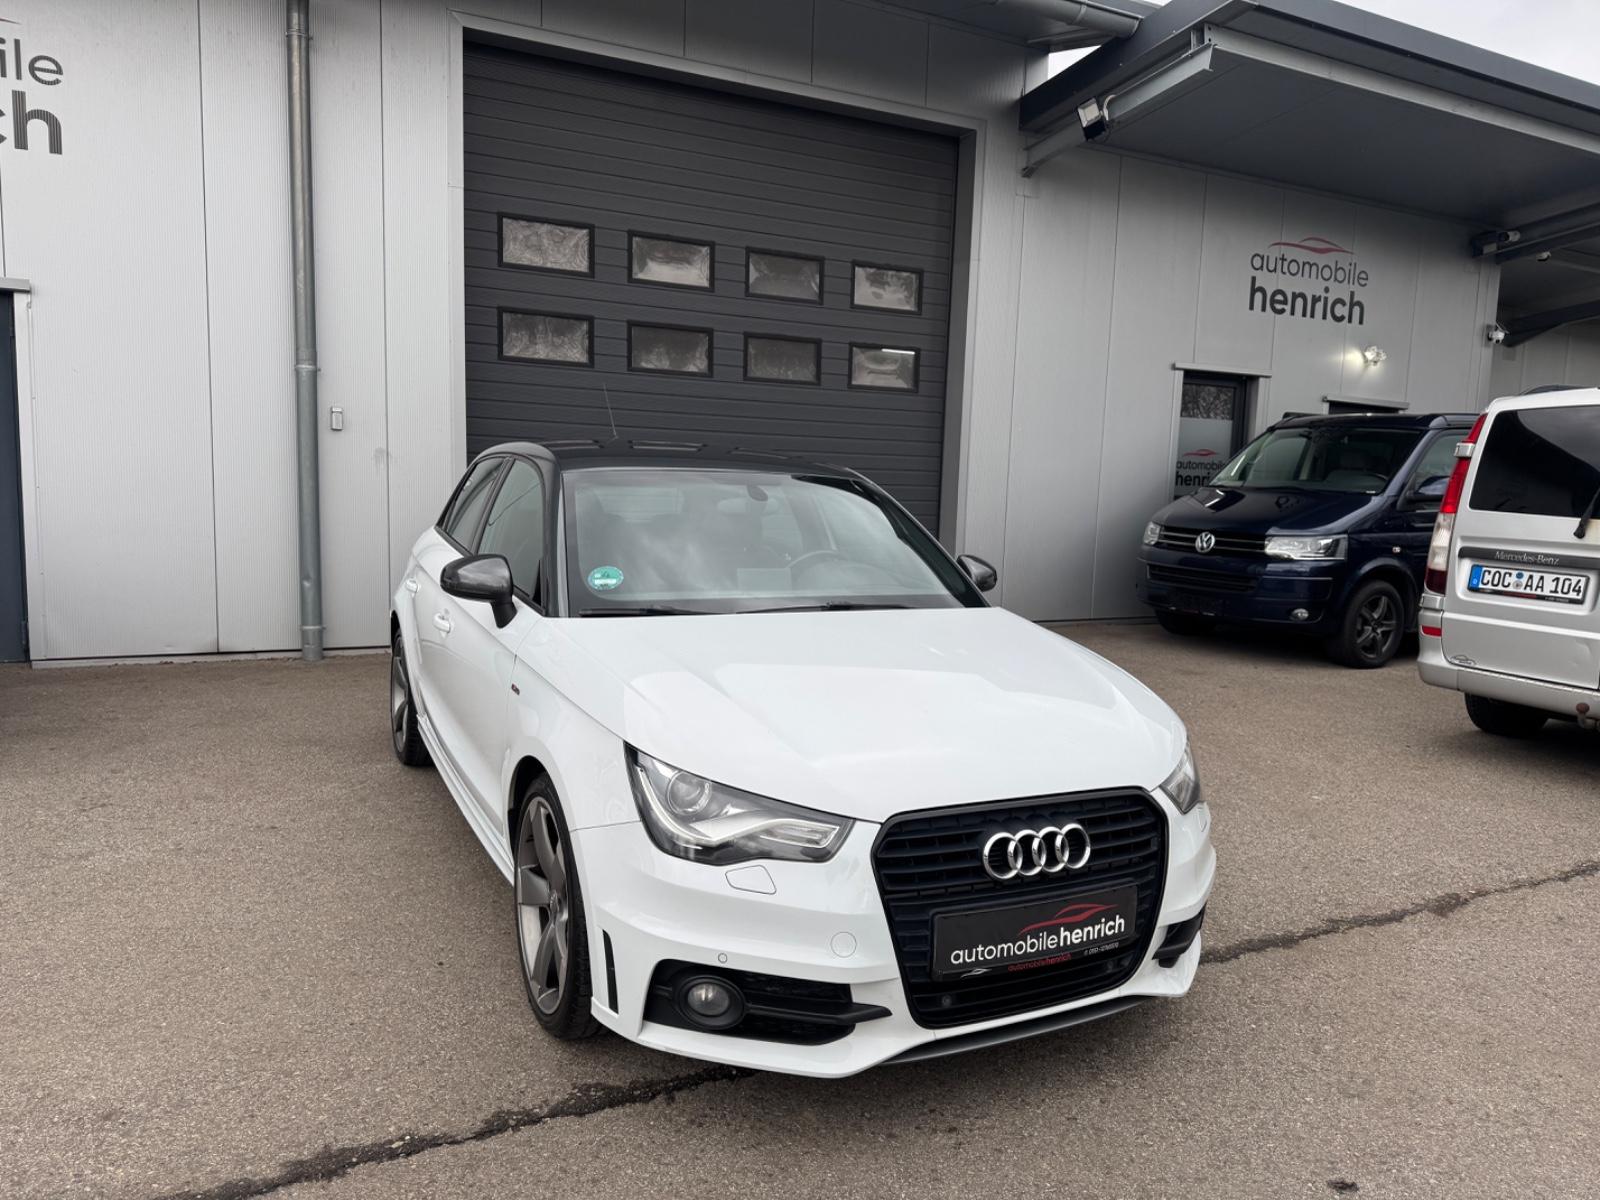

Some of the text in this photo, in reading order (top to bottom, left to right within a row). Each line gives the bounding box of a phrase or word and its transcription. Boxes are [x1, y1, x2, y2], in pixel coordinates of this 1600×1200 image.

[1250, 252, 1369, 288] automobile
[1248, 275, 1365, 325] henrich
[1495, 551, 1560, 566] Mercedes-Benz
[1480, 569, 1512, 588] COC
[1523, 574, 1545, 592] AA
[1549, 576, 1582, 597] 104
